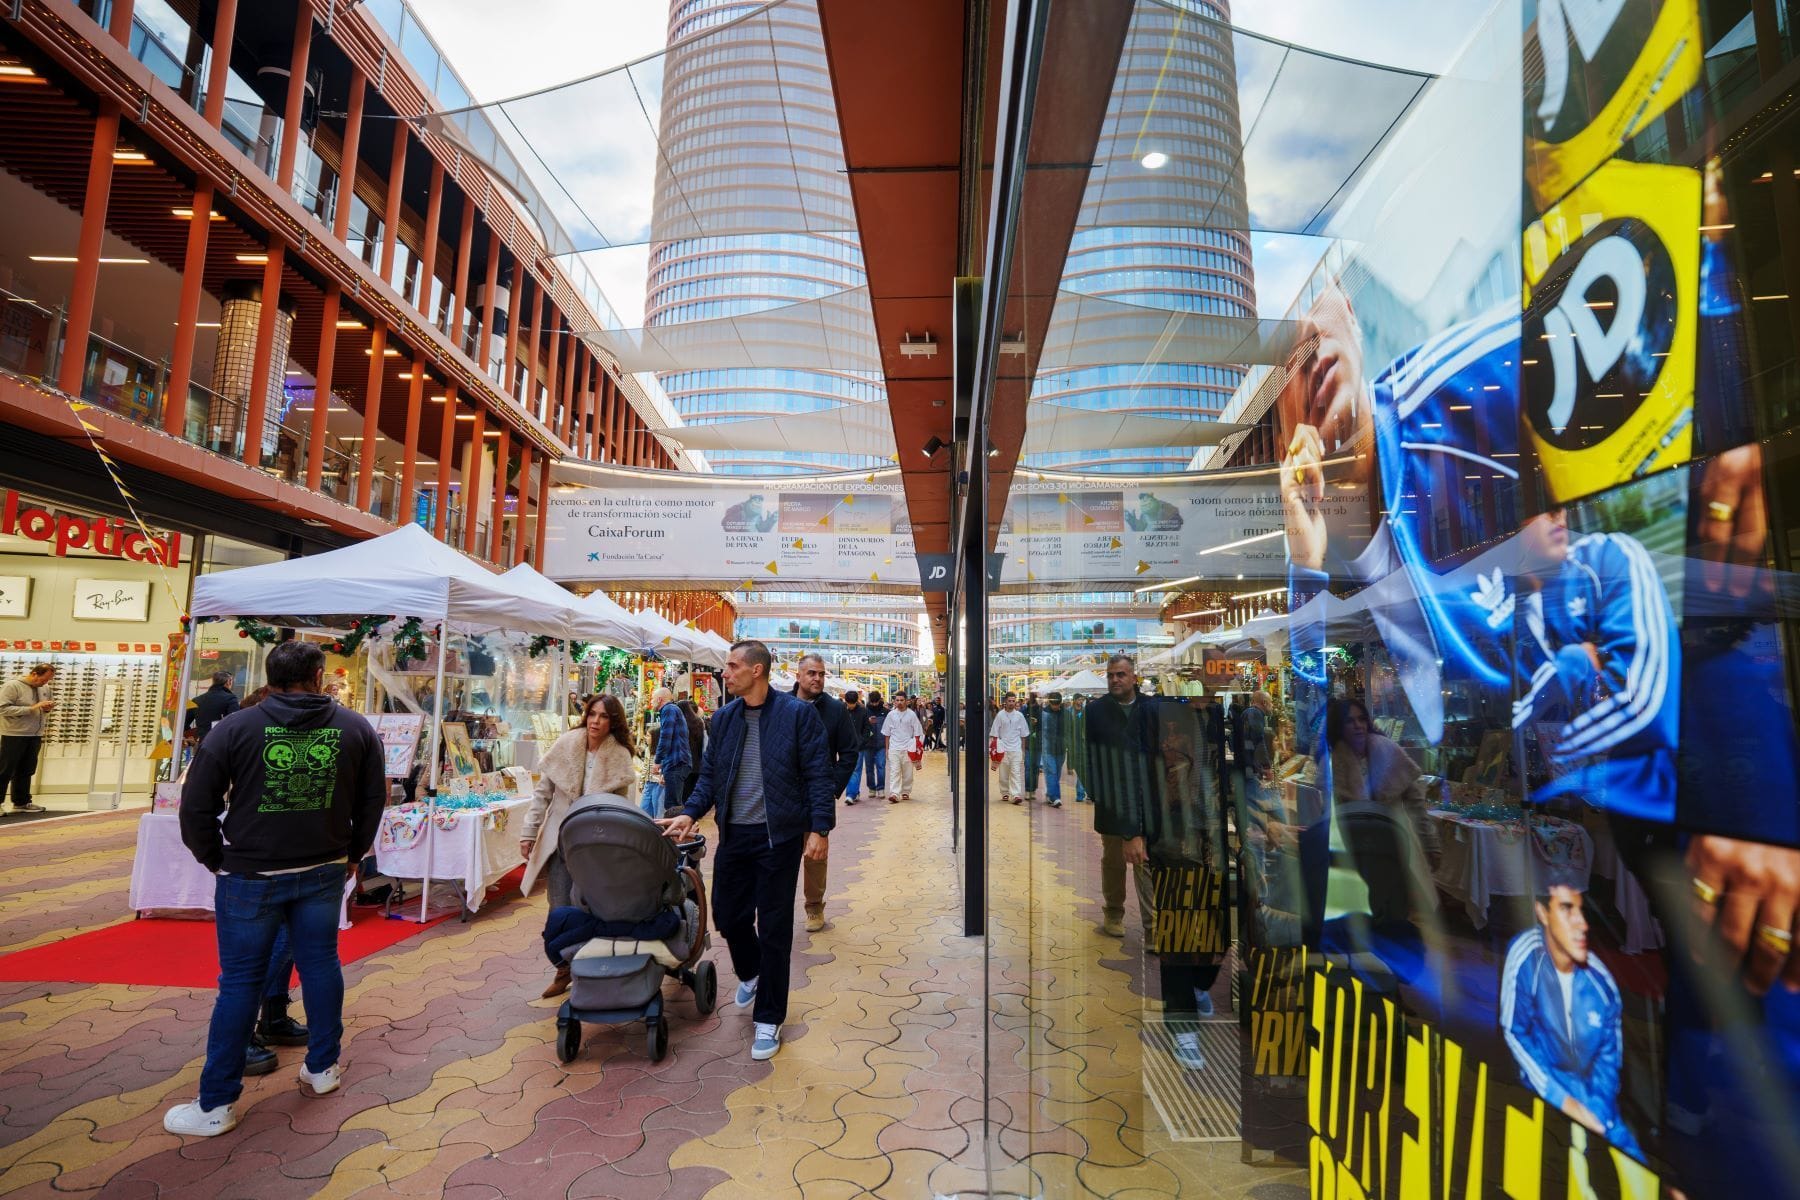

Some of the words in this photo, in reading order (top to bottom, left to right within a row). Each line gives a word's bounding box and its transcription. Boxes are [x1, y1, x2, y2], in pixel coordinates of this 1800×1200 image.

[1543, 235, 1647, 436] JD
[845, 484, 904, 492] EXPOSICIONES
[547, 497, 587, 506] reemos
[604, 497, 613, 506] la
[615, 498, 652, 507] cultura
[685, 499, 715, 507] motor
[567, 509, 580, 518] de
[583, 509, 660, 519] transformación
[662, 510, 691, 519] social
[588, 524, 665, 538] CaixaForum
[929, 566, 946, 579] JD
[86, 589, 134, 610] Ray-Ban
[832, 651, 869, 664] fnac
